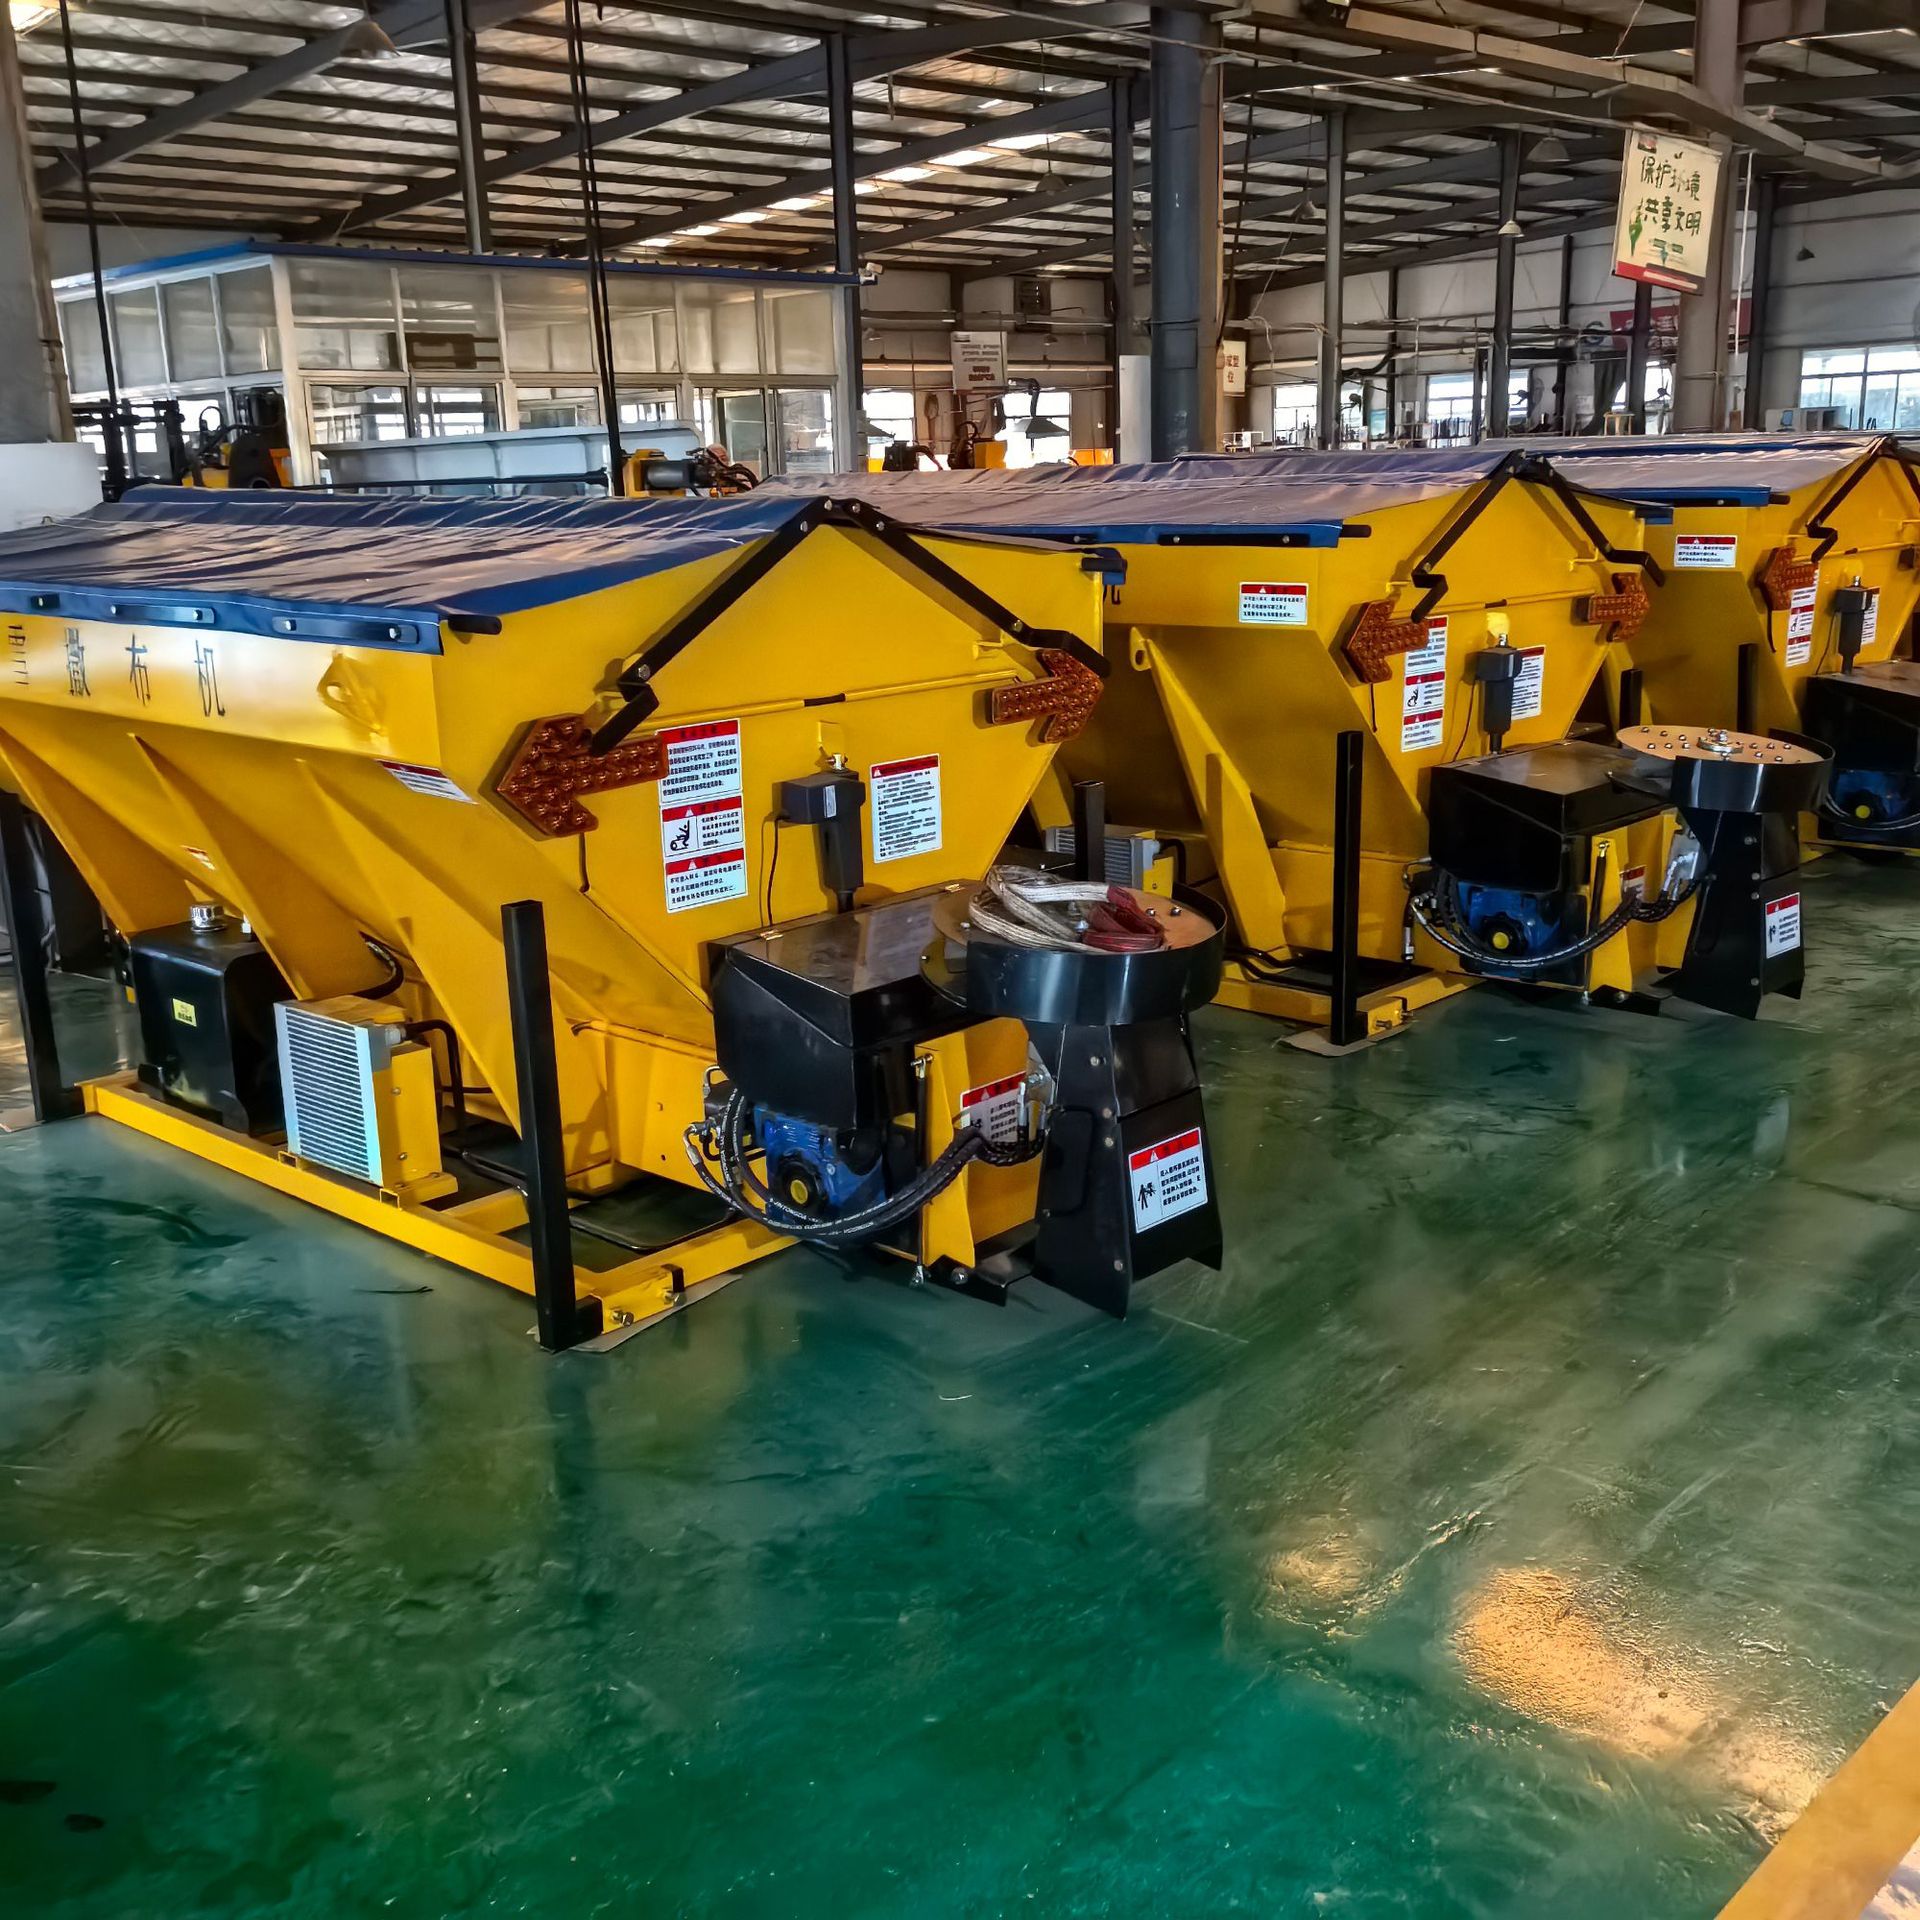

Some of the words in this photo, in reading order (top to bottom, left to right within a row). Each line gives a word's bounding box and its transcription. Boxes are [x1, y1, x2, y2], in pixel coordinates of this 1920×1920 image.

[1640, 156, 1701, 201] 保护环境
[1643, 196, 1702, 236] 共享文明
